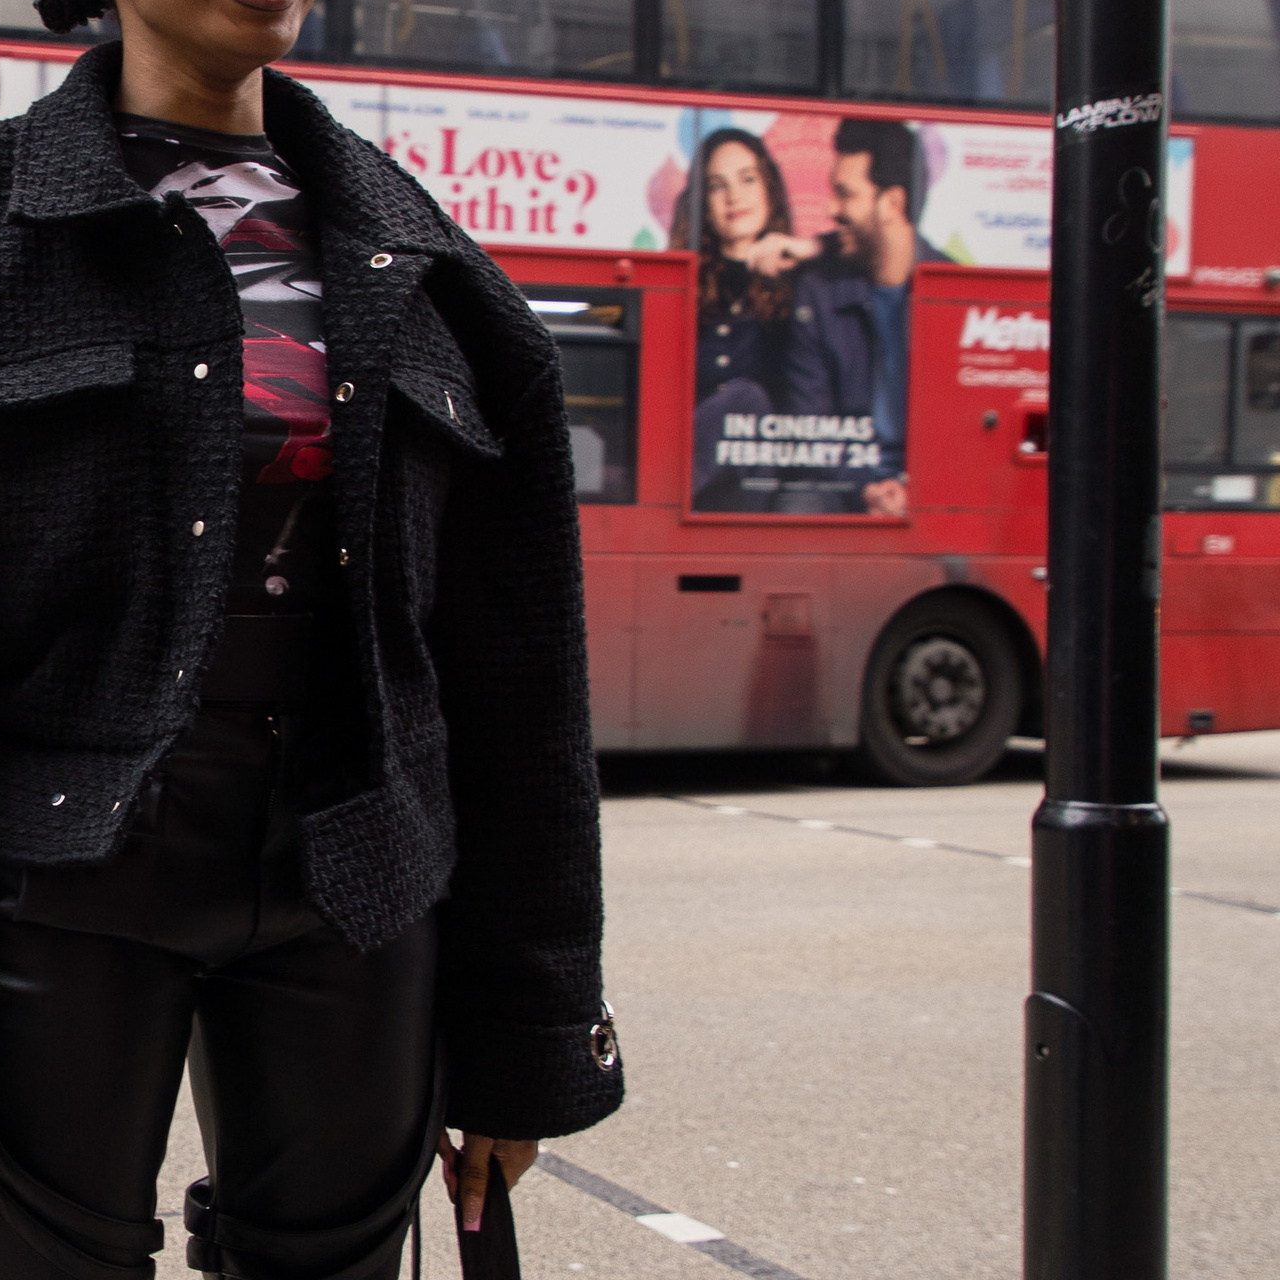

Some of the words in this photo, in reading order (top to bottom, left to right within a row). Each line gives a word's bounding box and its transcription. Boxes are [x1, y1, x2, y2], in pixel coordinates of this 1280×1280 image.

[439, 128, 559, 182] Love
[442, 184, 515, 232] ith
[724, 413, 756, 438] IN
[759, 414, 875, 441] CINEMAS
[716, 440, 844, 467] FEBRUARY
